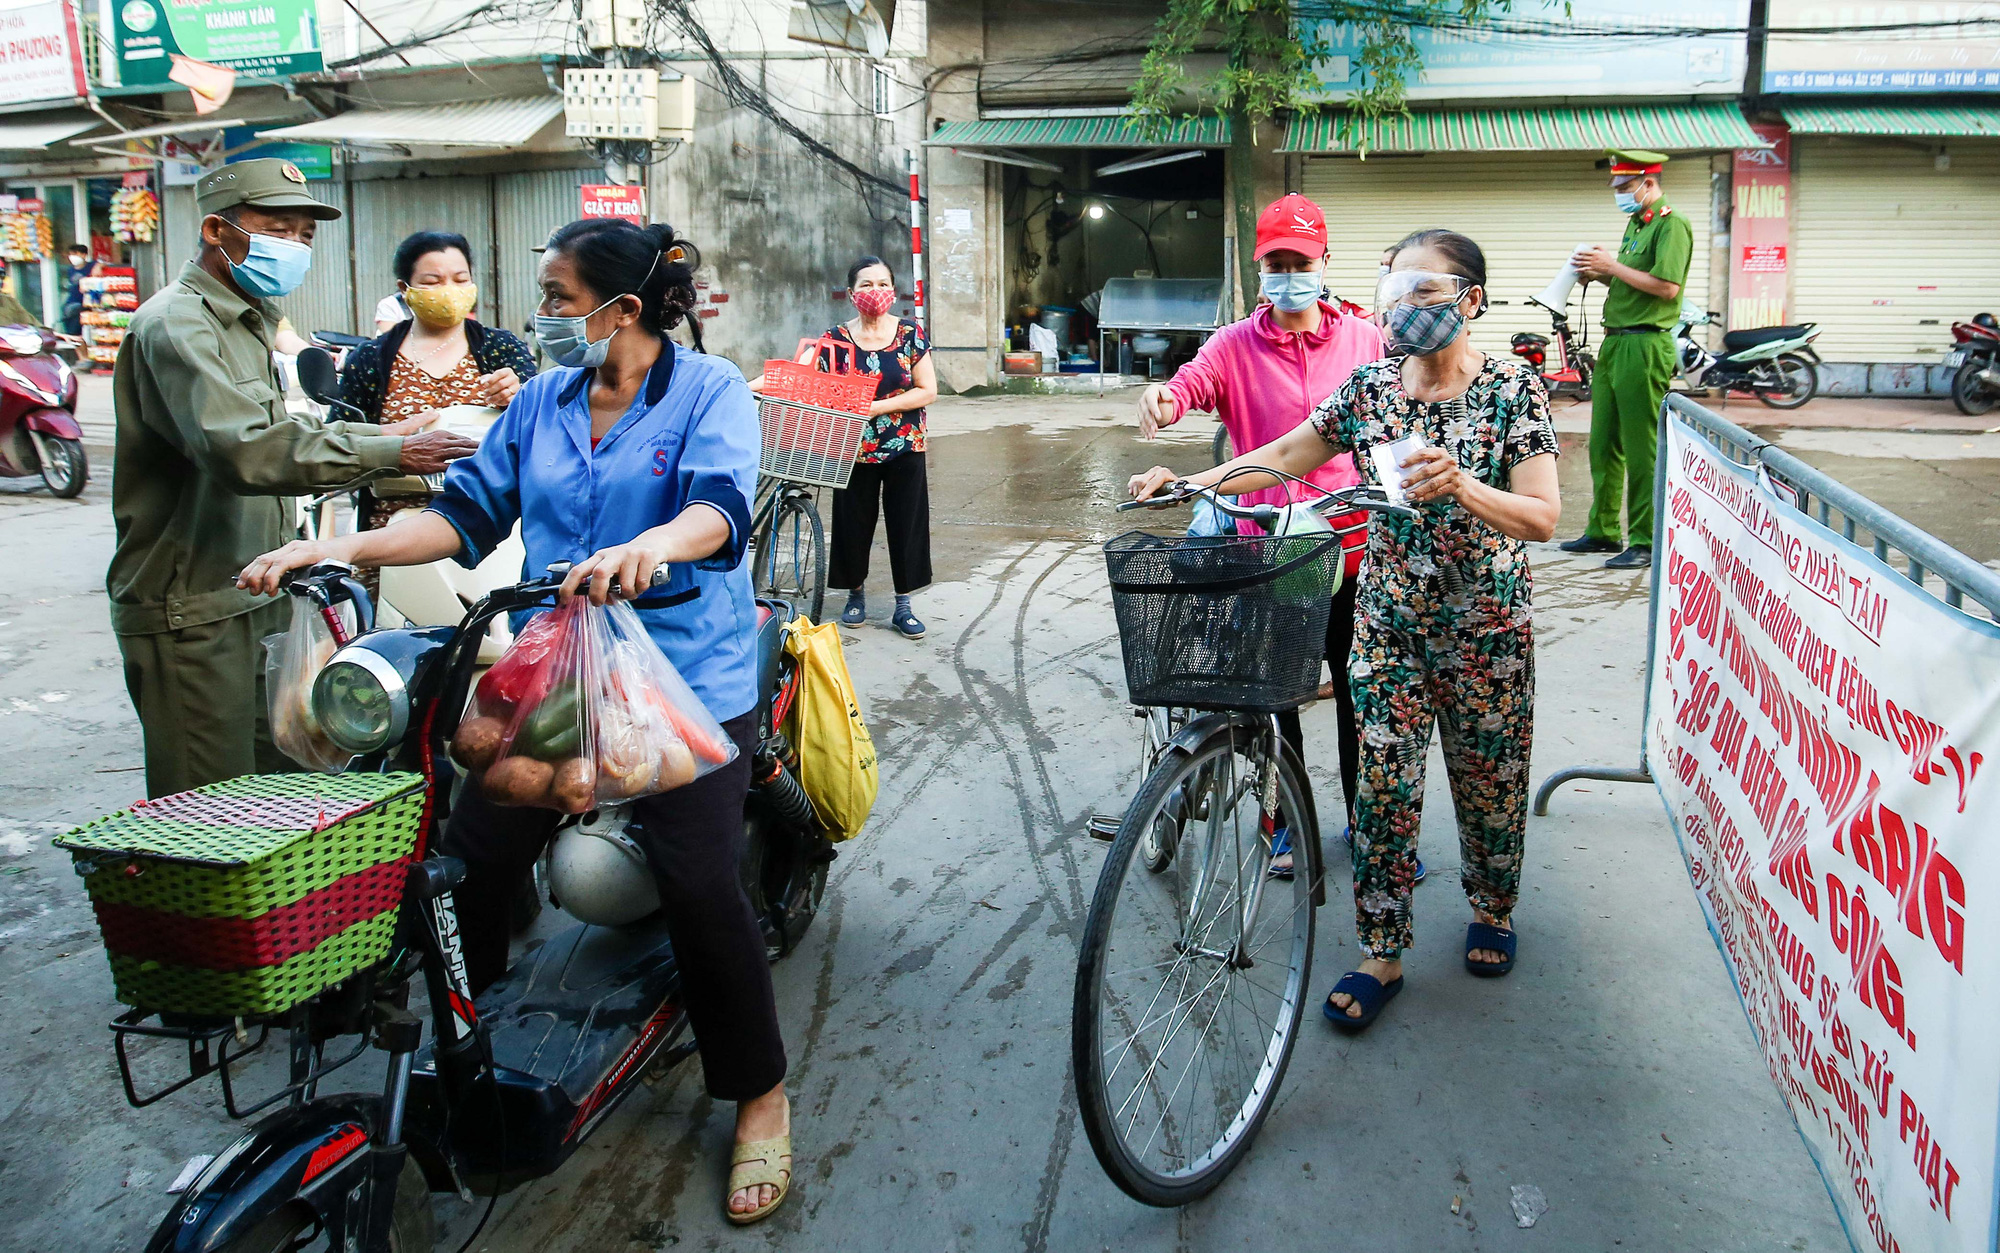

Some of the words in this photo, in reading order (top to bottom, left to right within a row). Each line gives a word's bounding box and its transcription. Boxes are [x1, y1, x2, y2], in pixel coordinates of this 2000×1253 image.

[651, 448, 669, 477] S
[1682, 443, 1698, 475] ỦY
[1694, 458, 1718, 492] BAN
[1759, 508, 1802, 574] PHNG
[1802, 546, 1846, 606] NHẬT
[1849, 576, 1888, 639] TÂN
[1759, 590, 1803, 663] CHỐNG
[1797, 625, 1837, 697] DỊCH
[1836, 656, 1889, 743] BỆNH
[1886, 699, 1984, 814] COVI-1
[1710, 697, 1748, 778] ĐỊA
[1740, 734, 1787, 840] ĐIỂM
[1684, 813, 1713, 858] điểm
[607, 1053, 634, 1086] DESIGNED
[640, 1025, 655, 1046] GIANT
[1719, 815, 1744, 873] ĐEO
[1761, 895, 1815, 1002] TRANG
[1831, 1008, 1861, 1084] BỊ
[1860, 1039, 1895, 1119] XỬ
[1900, 1089, 1961, 1224] PHẠT
[1777, 975, 1813, 1071] RIỆU
